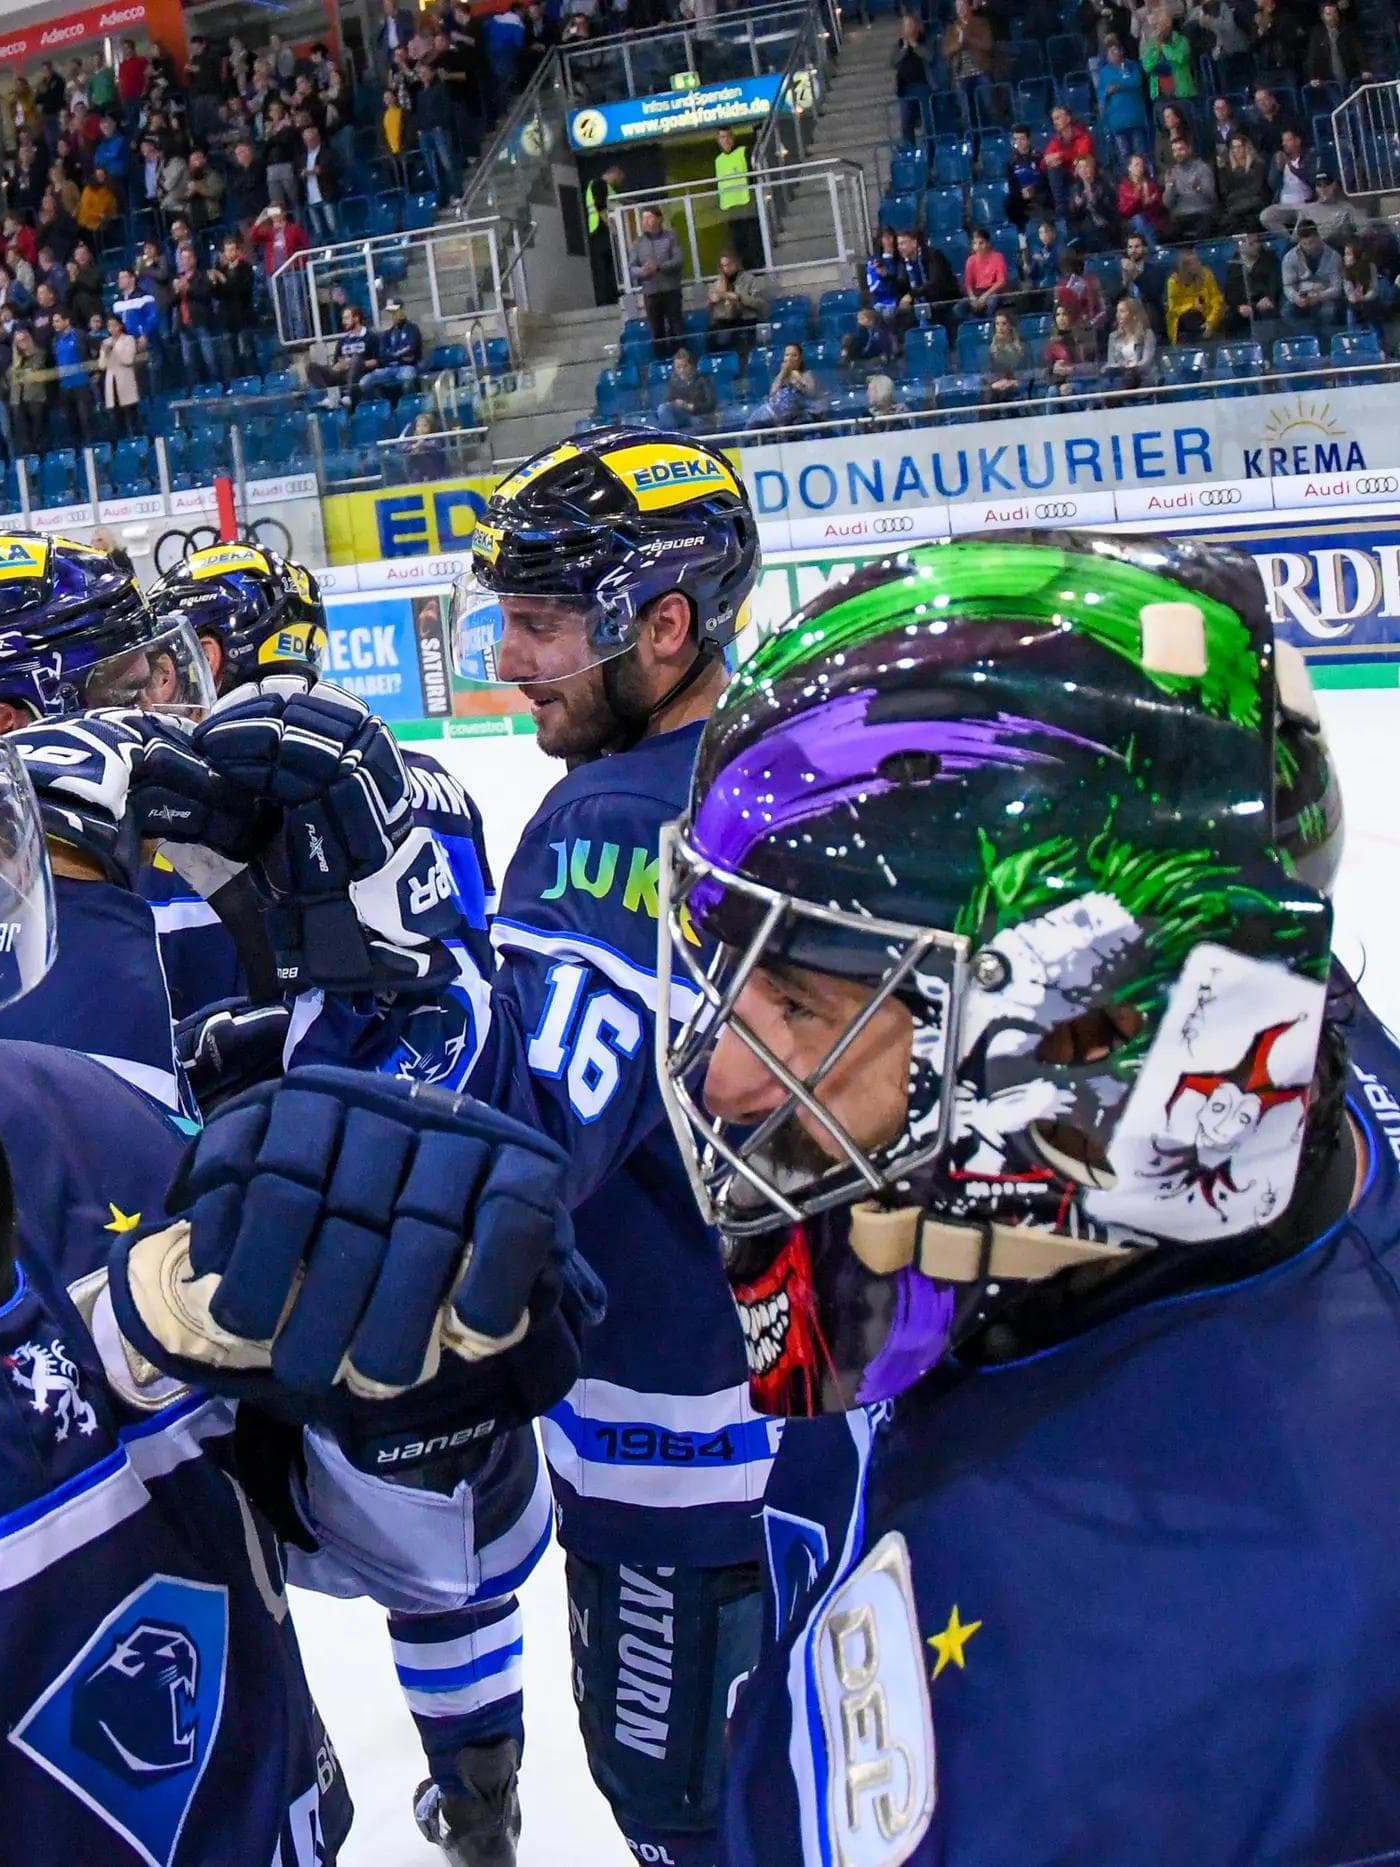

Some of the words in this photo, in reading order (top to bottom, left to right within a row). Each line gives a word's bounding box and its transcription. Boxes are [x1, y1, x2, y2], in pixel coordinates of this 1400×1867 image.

[100, 5, 145, 27] Adecco
[41, 23, 85, 44] Adecco
[642, 98, 668, 114] Infos
[620, 97, 770, 137] www.goalsforkids.de
[1243, 439, 1367, 479] KREMA
[634, 457, 721, 486] EDEKA
[753, 425, 1214, 515] DONAUKURIER
[251, 491, 282, 506] Audi
[1304, 479, 1352, 499] Audi
[103, 505, 130, 518] Audi
[176, 497, 205, 510] Audi
[1147, 492, 1194, 511] Audi
[984, 506, 1030, 524] Audi
[824, 522, 868, 538] Audi
[387, 565, 425, 580] Audi
[421, 637, 448, 713] SATURN
[526, 961, 645, 1127] 16
[594, 1426, 736, 1463] 1964
